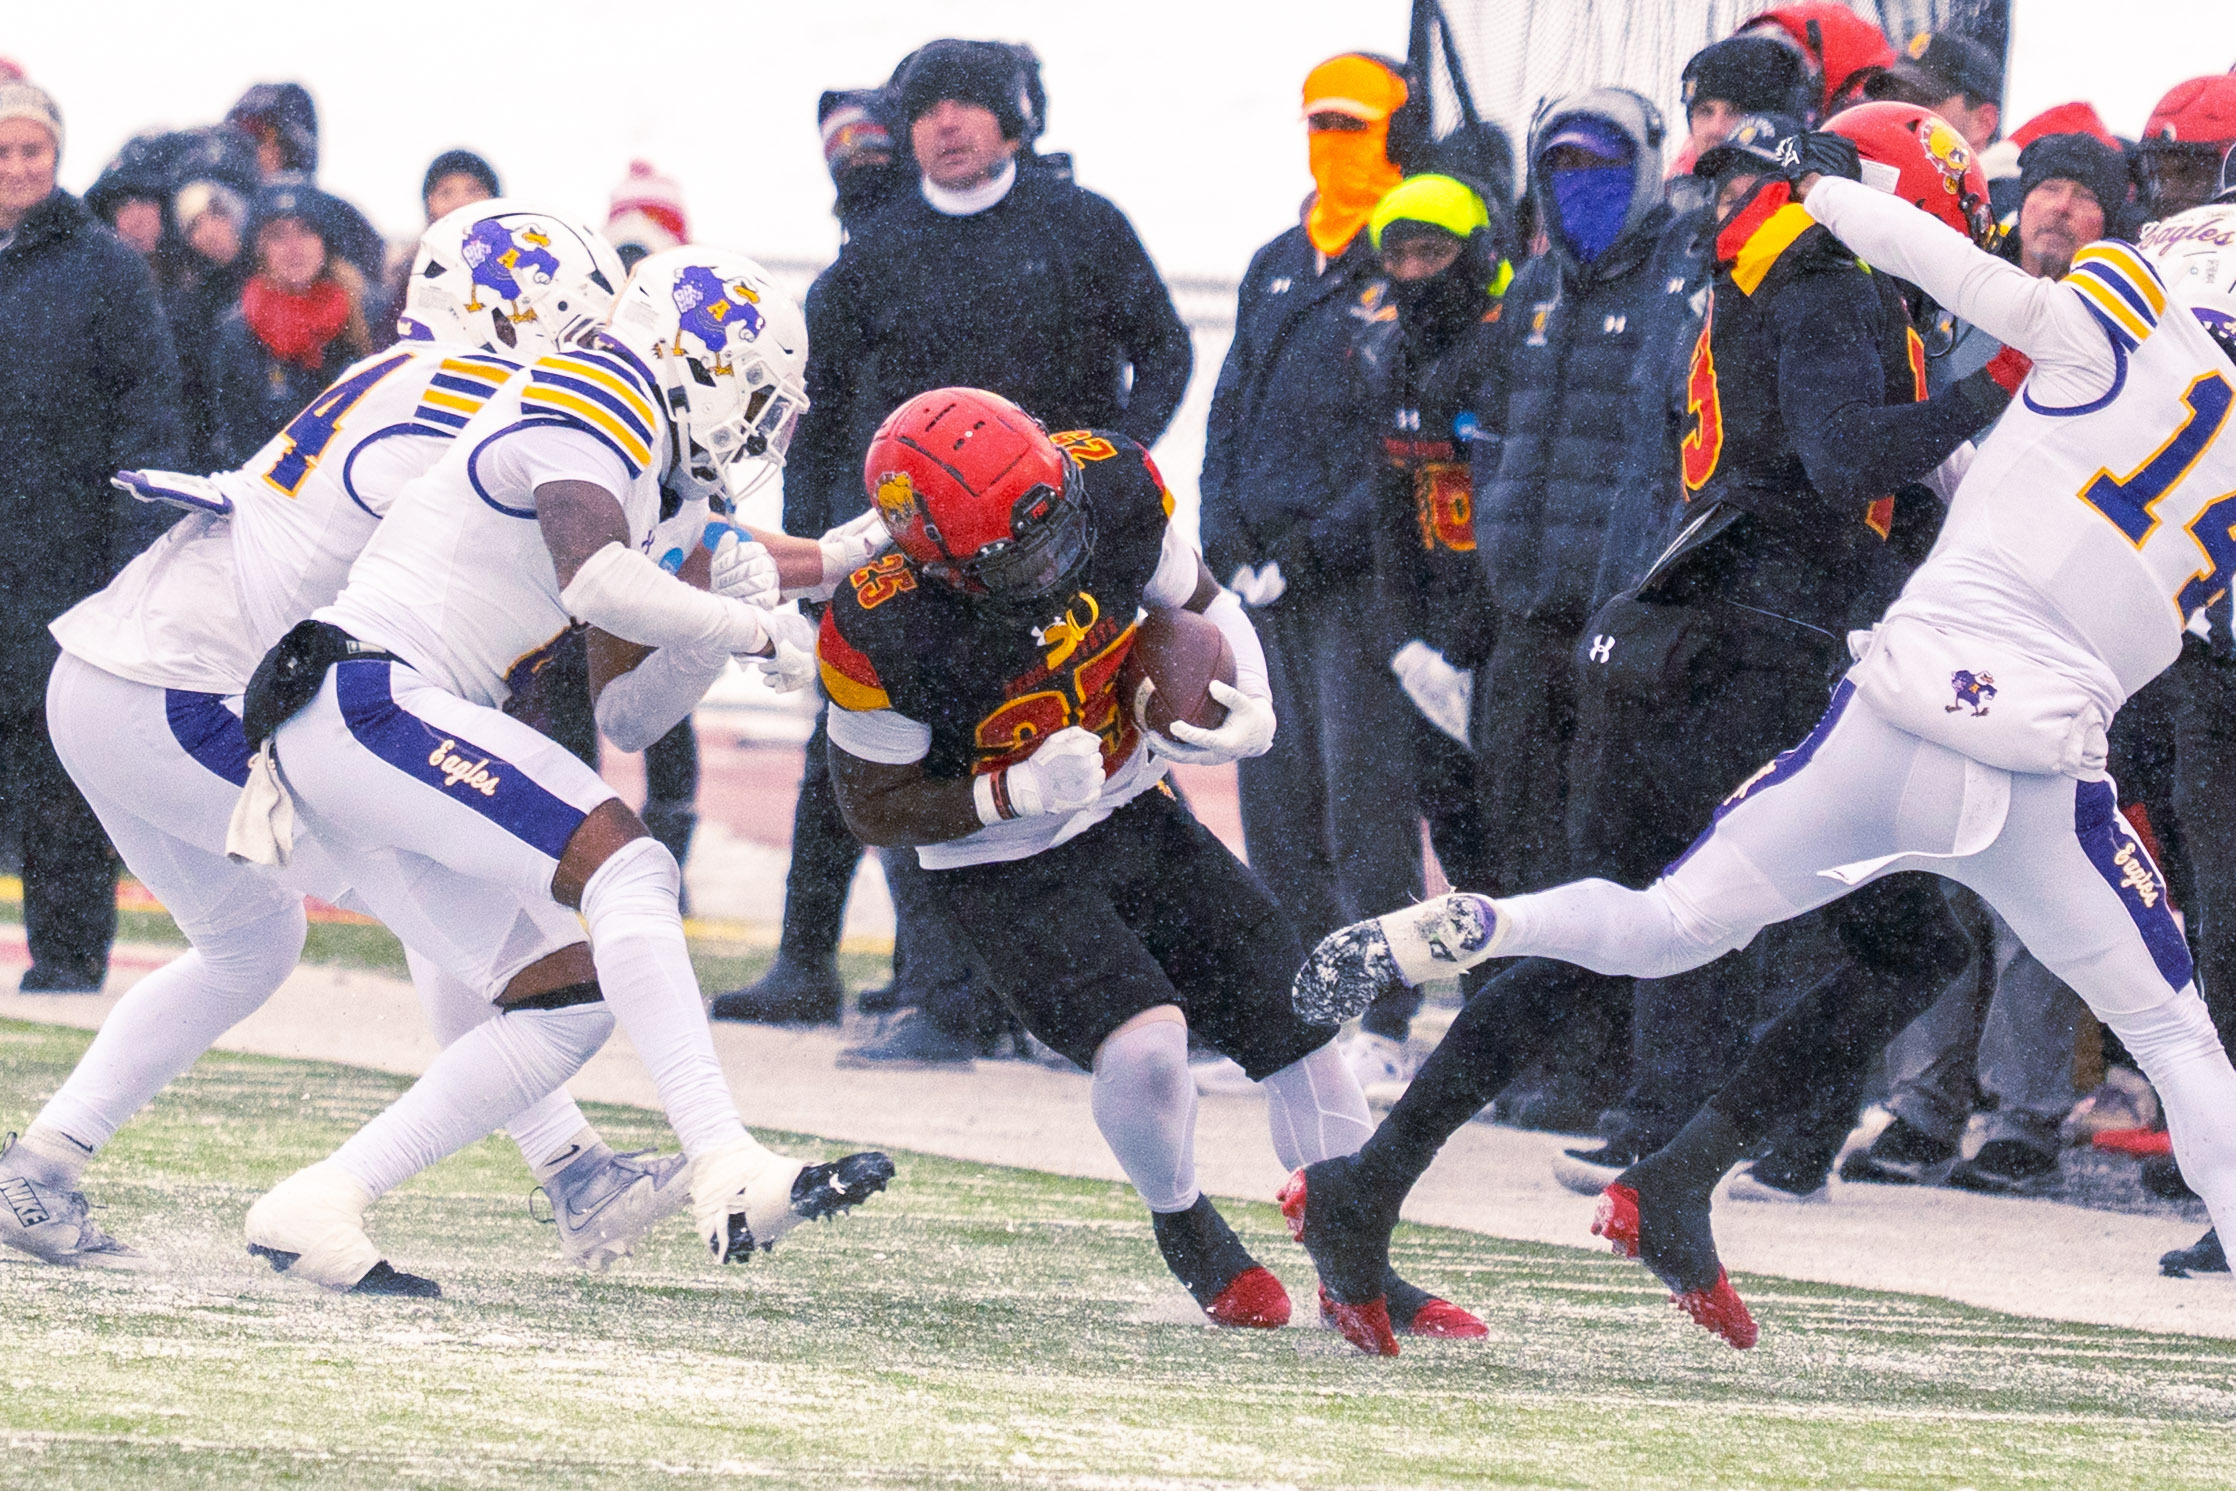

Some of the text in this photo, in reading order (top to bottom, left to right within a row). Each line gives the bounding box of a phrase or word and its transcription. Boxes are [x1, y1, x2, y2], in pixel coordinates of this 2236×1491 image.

[2139, 218, 2236, 256] Eagles
[262, 352, 417, 498] 4
[849, 554, 918, 610] 25
[428, 739, 500, 796] Eagles
[2115, 842, 2159, 908] Eagles
